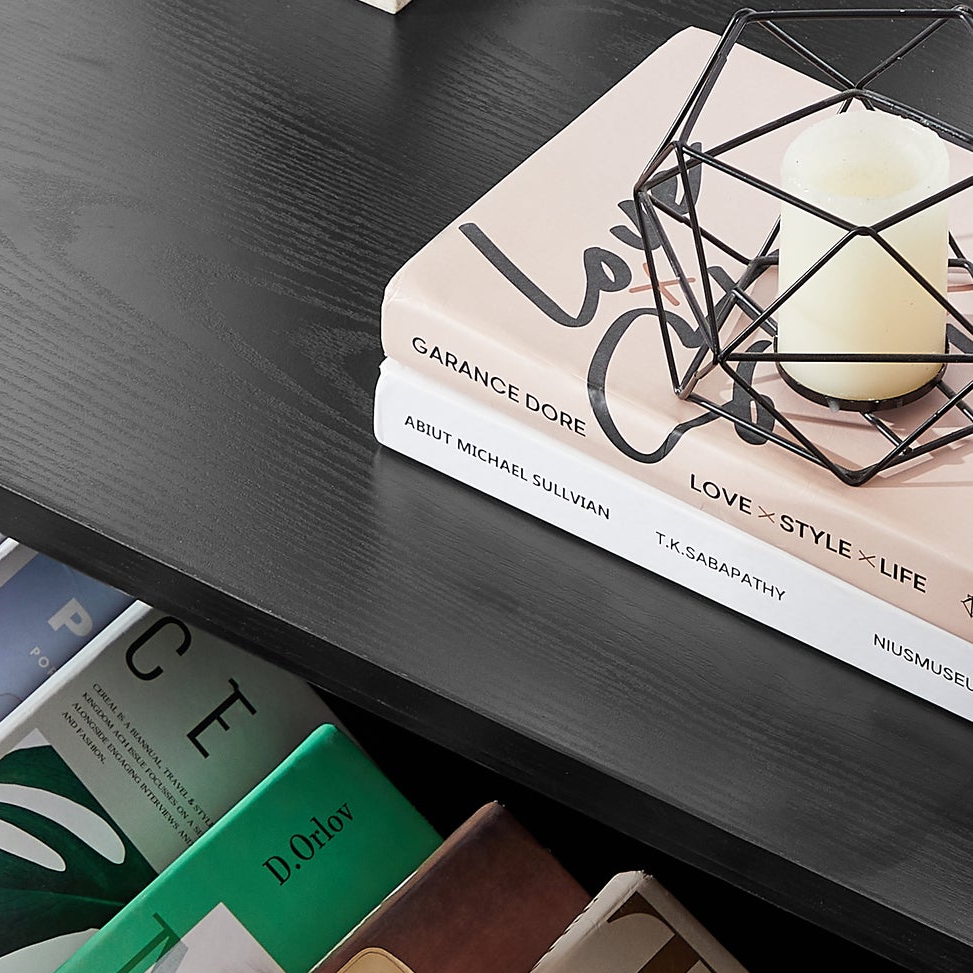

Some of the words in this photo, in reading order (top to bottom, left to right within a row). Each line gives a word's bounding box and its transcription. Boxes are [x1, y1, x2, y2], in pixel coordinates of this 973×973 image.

[411, 336, 520, 404] GARANCE
[525, 392, 587, 437] DORE
[404, 415, 453, 445] ABIUT
[456, 438, 528, 482] MICHAEL
[532, 474, 611, 520] SULLVIAN
[655, 531, 786, 601] T.K.SABAPATHY
[689, 473, 753, 516] LOVE
[779, 513, 853, 560] STYLE
[879, 557, 928, 594] LIFE
[47, 597, 94, 637] P
[62, 711, 79, 729] AND
[71, 702, 108, 744] ALONGSIDE
[107, 743, 142, 785] ENGAGING
[140, 782, 180, 830] INTERVIEWS
[82, 691, 115, 730] KINGDOM
[127, 746, 148, 769] ISSUE
[145, 767, 178, 807] FOCUSSES
[176, 805, 189, 820] ON
[92, 683, 118, 714] CEREAL
[116, 711, 125, 722] IS
[124, 721, 132, 730] A
[163, 766, 189, 799] TRAVEL
[262, 801, 356, 887] D.Orlov
